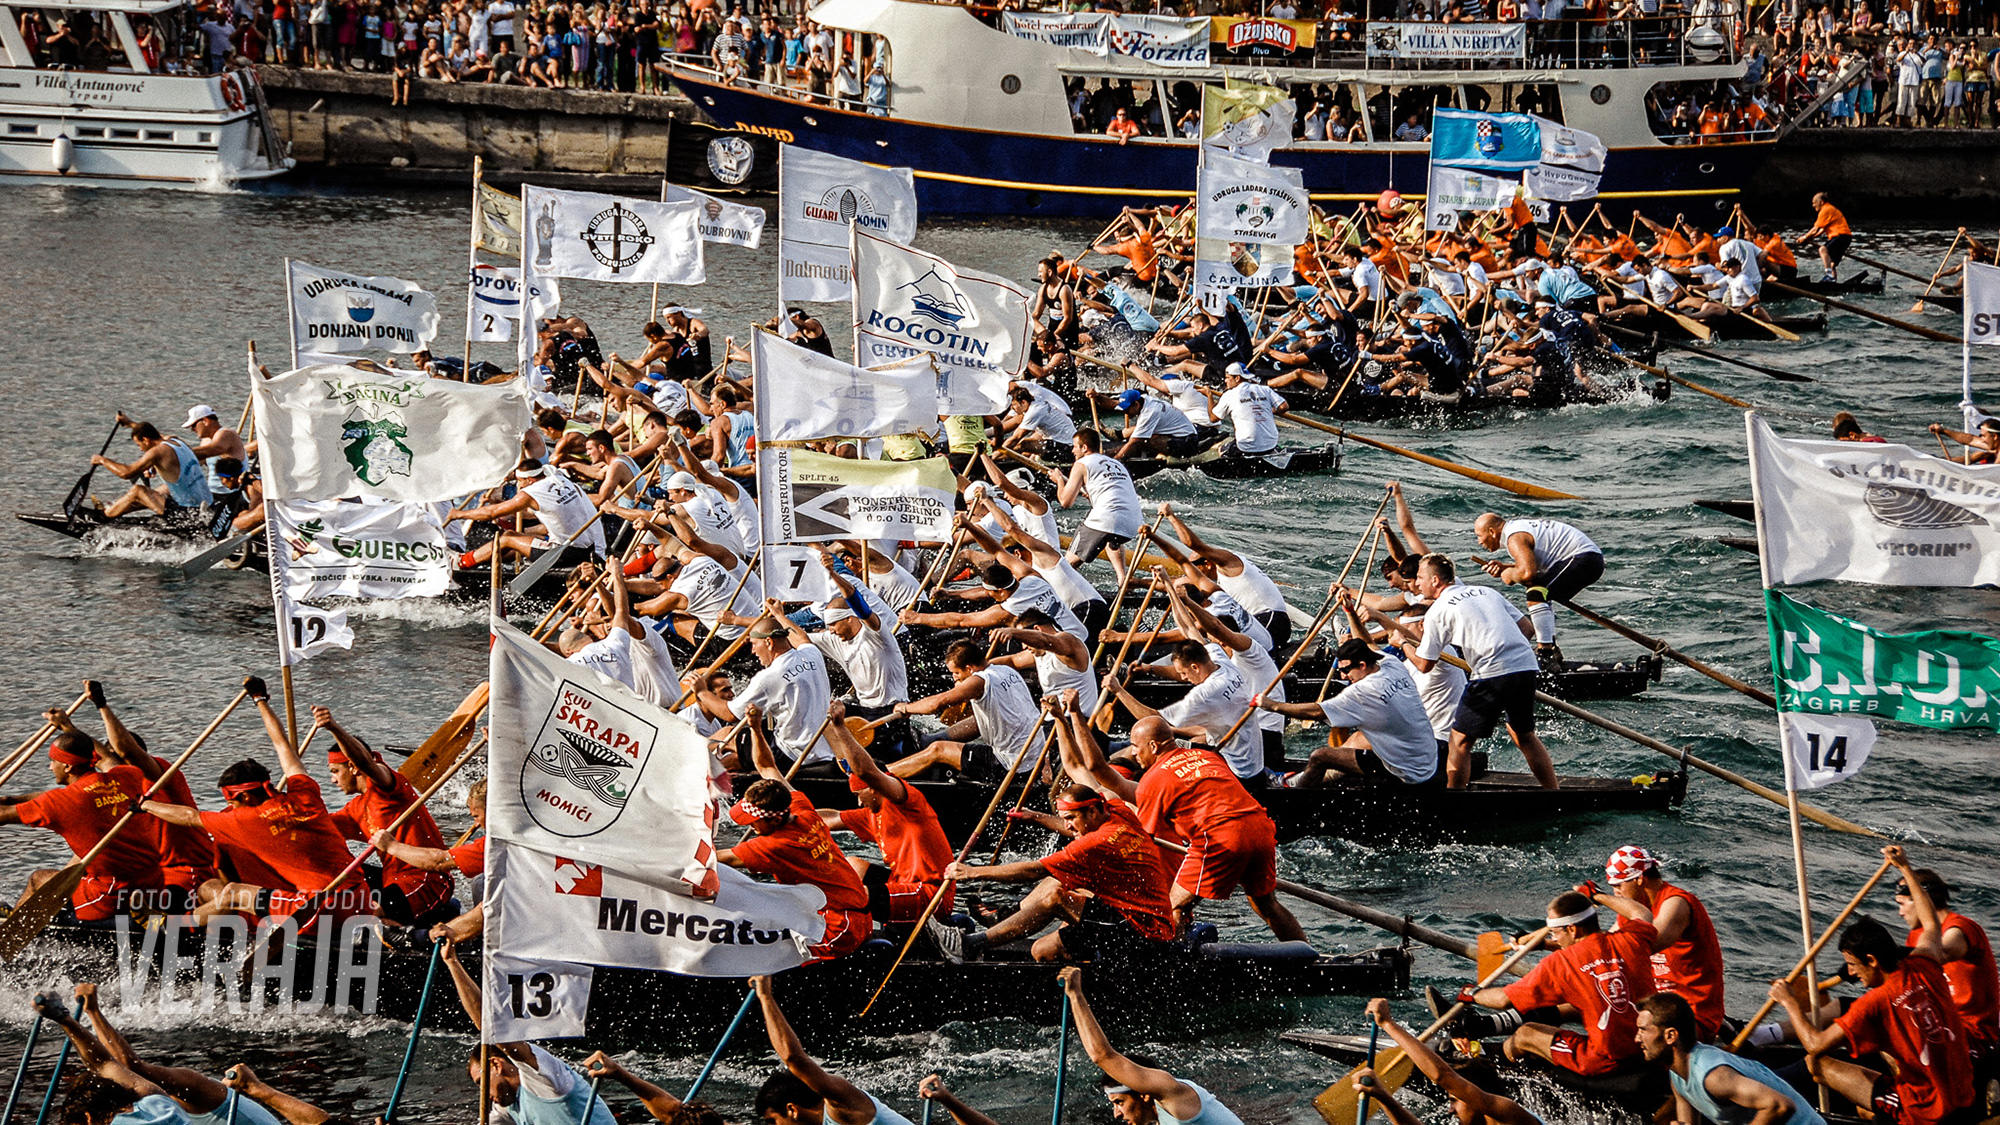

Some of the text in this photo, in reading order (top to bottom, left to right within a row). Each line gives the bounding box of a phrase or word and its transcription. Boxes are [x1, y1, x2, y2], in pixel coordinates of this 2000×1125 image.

[1014, 18, 1098, 31] hotel restaurant
[1233, 20, 1291, 45] Ožujsko
[1424, 26, 1501, 35] hotel restaurant
[1125, 30, 1206, 61] Forzita
[1408, 35, 1516, 49] VILLA NERETVA
[35, 75, 144, 93] Villa Antunović
[1212, 185, 1240, 202] UDRUGA
[590, 208, 618, 230] UDRUGA
[806, 206, 887, 230] GUSARI KOMIN
[1436, 213, 1452, 226] 22
[1529, 204, 1541, 217] 26
[617, 234, 653, 244] ROKO
[699, 224, 752, 242] DUBROVNIK
[785, 258, 853, 284] Dalmacij
[1209, 273, 1280, 286] ČAPLJINA
[303, 277, 359, 299] UDRUGA
[1204, 292, 1217, 308] 11
[308, 323, 414, 343] DONJANI DONJI
[483, 313, 494, 333] 2
[868, 309, 989, 357] ROGOTIN
[799, 474, 839, 483] SPLIT 45
[778, 451, 792, 540] KONSTRUKTOR
[852, 496, 945, 508] KONSTRUKTOR
[900, 514, 935, 526] SPLIT
[789, 559, 807, 589] 7
[291, 616, 326, 648] 12
[575, 653, 618, 664] LOČE
[782, 660, 817, 682] PLOČE
[1781, 694, 1879, 711] ZAGREB
[1921, 705, 2000, 724] HRVA
[1807, 733, 1848, 773] 14
[536, 788, 592, 823] MOMIĆI
[507, 971, 556, 1019] 13
